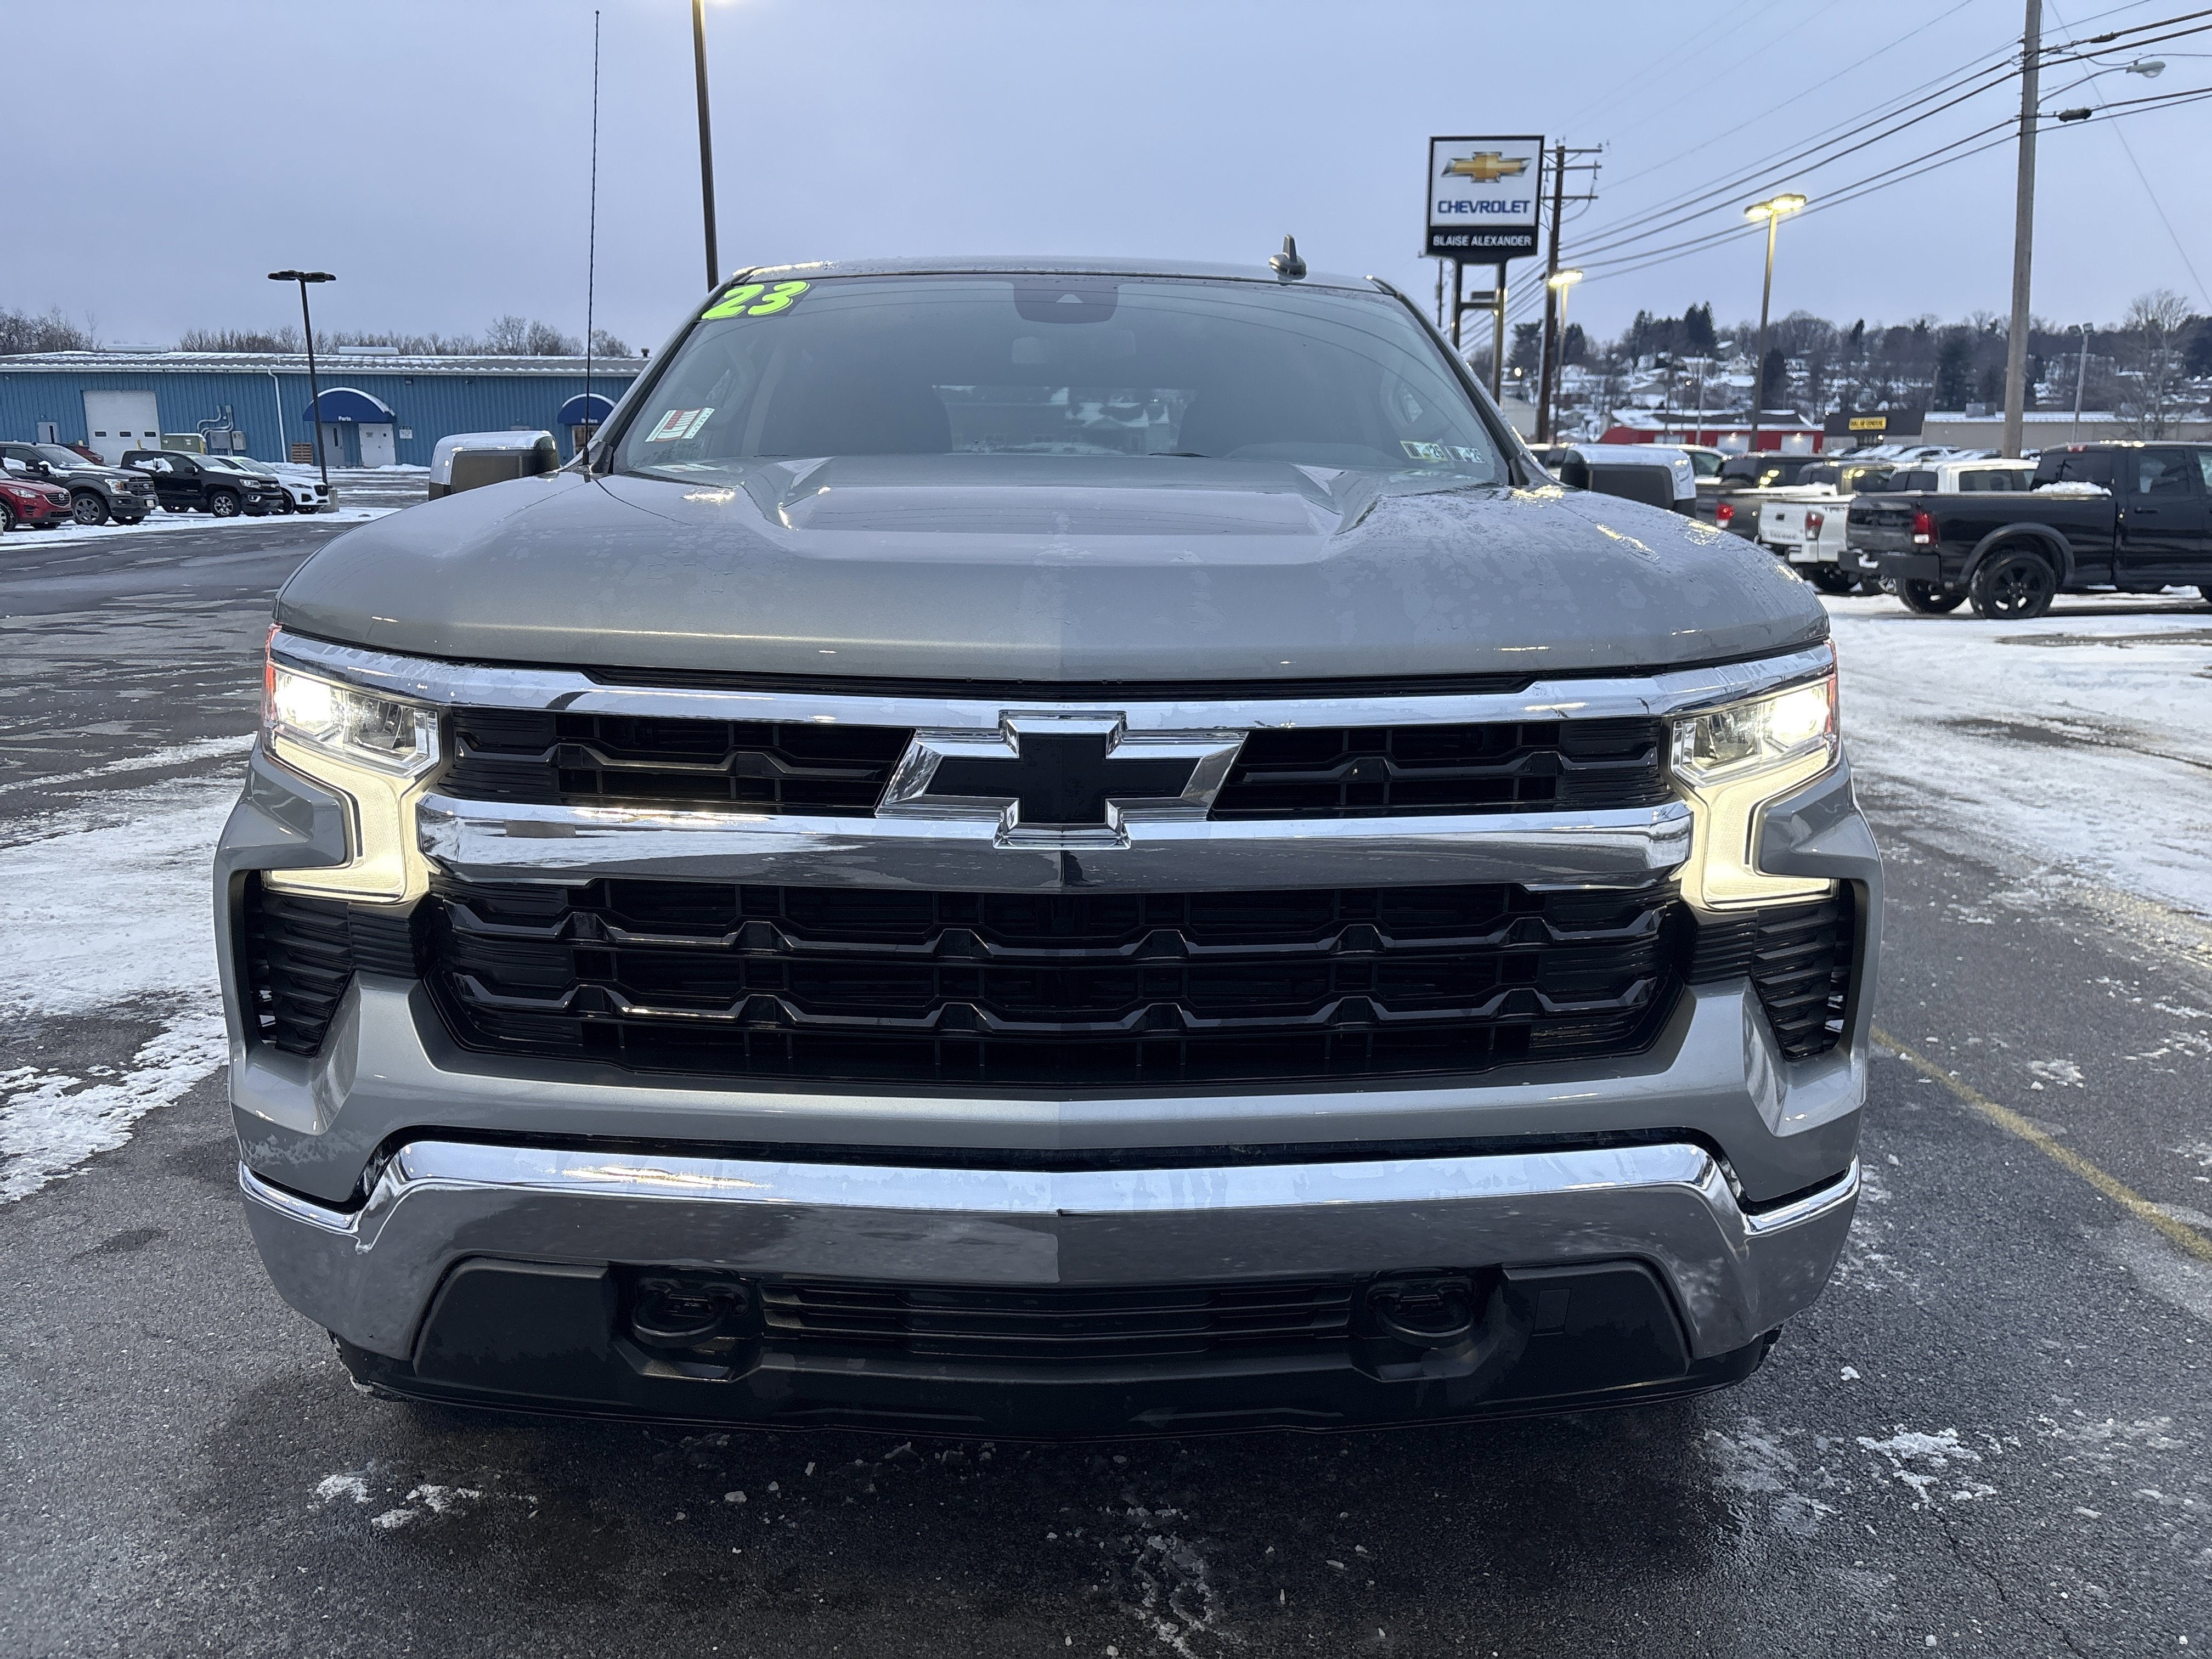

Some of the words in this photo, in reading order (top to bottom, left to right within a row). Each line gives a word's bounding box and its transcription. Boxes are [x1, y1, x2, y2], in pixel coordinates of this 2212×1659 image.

[1437, 200, 1531, 213] CHEVROLET
[1432, 235, 1469, 246] BLAISE
[1471, 235, 1532, 246] ALEXANDER
[701, 280, 810, 320] 23
[1429, 445, 1445, 458] 26
